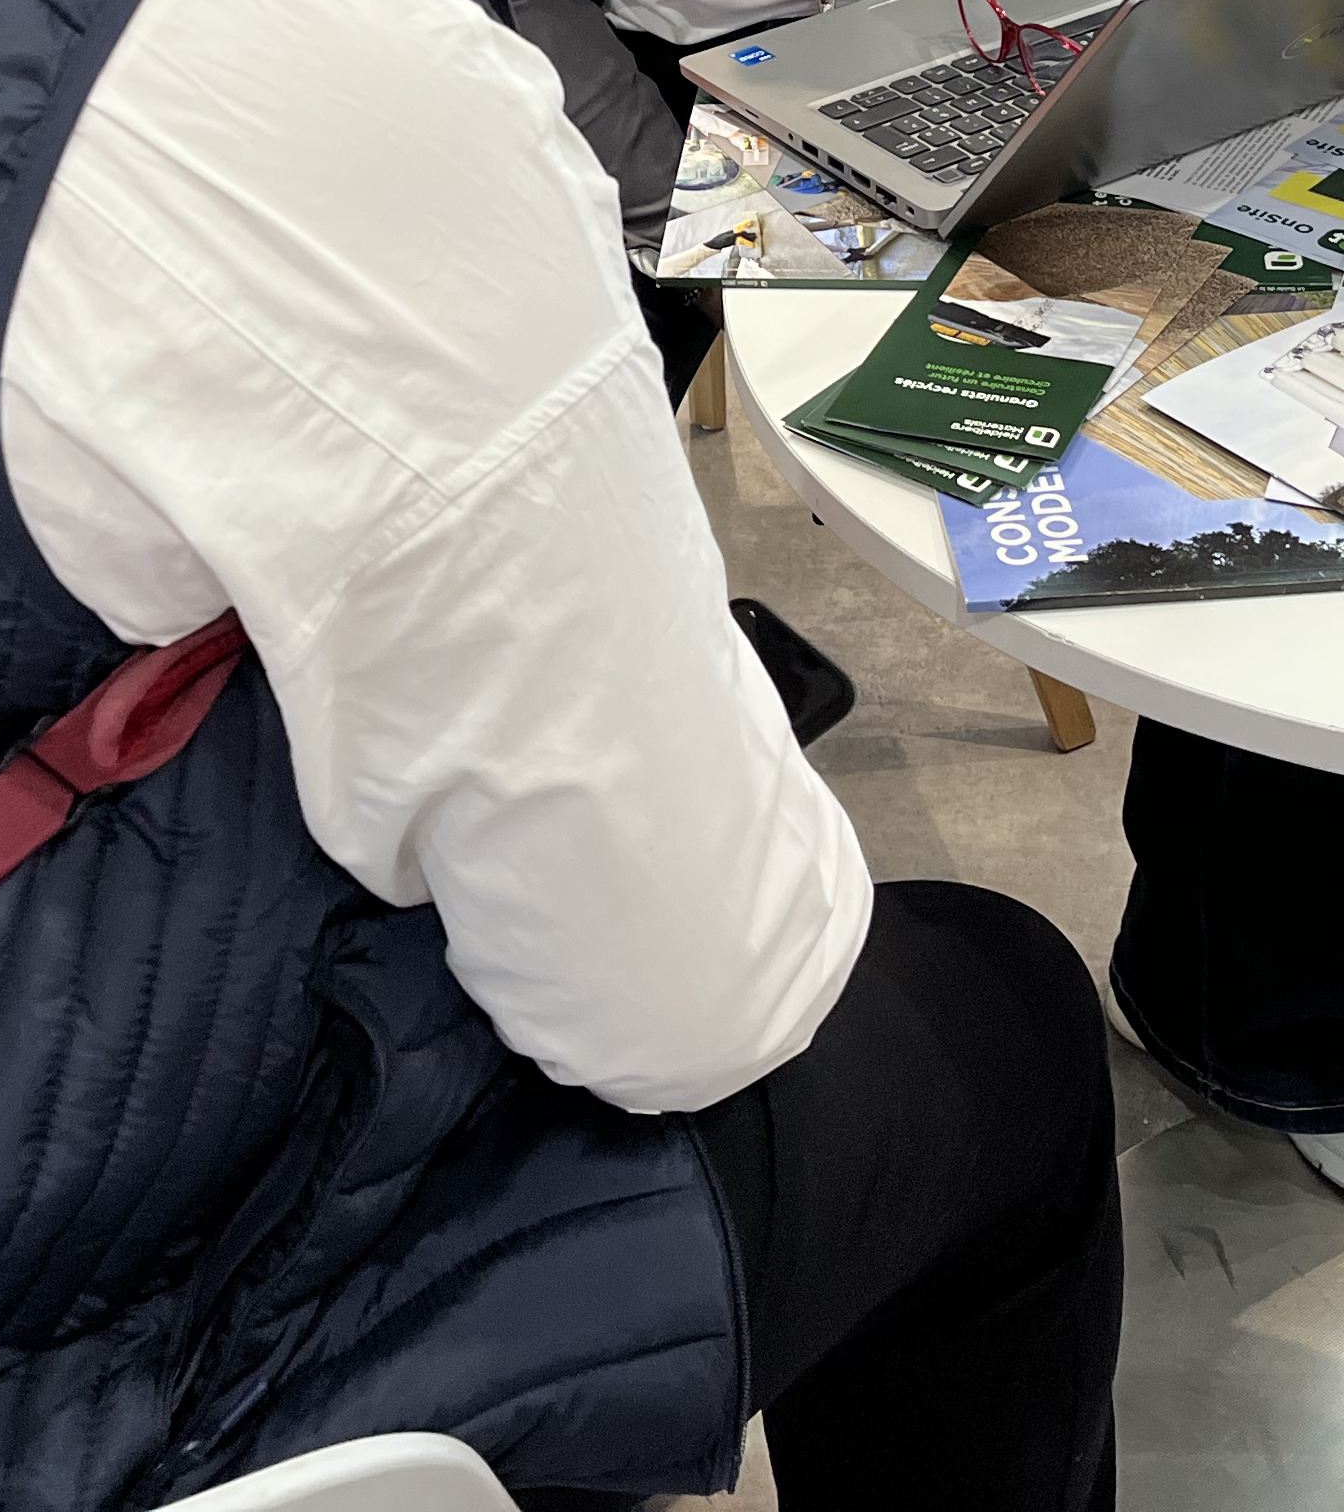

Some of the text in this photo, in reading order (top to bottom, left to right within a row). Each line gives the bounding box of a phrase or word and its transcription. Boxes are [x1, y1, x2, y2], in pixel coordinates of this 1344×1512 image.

[1236, 203, 1314, 235] OnSite
[981, 380, 1047, 396] Construire
[960, 389, 1040, 408] Granulats
[950, 422, 1021, 441] Heidelberg
[964, 419, 1025, 434] Materials
